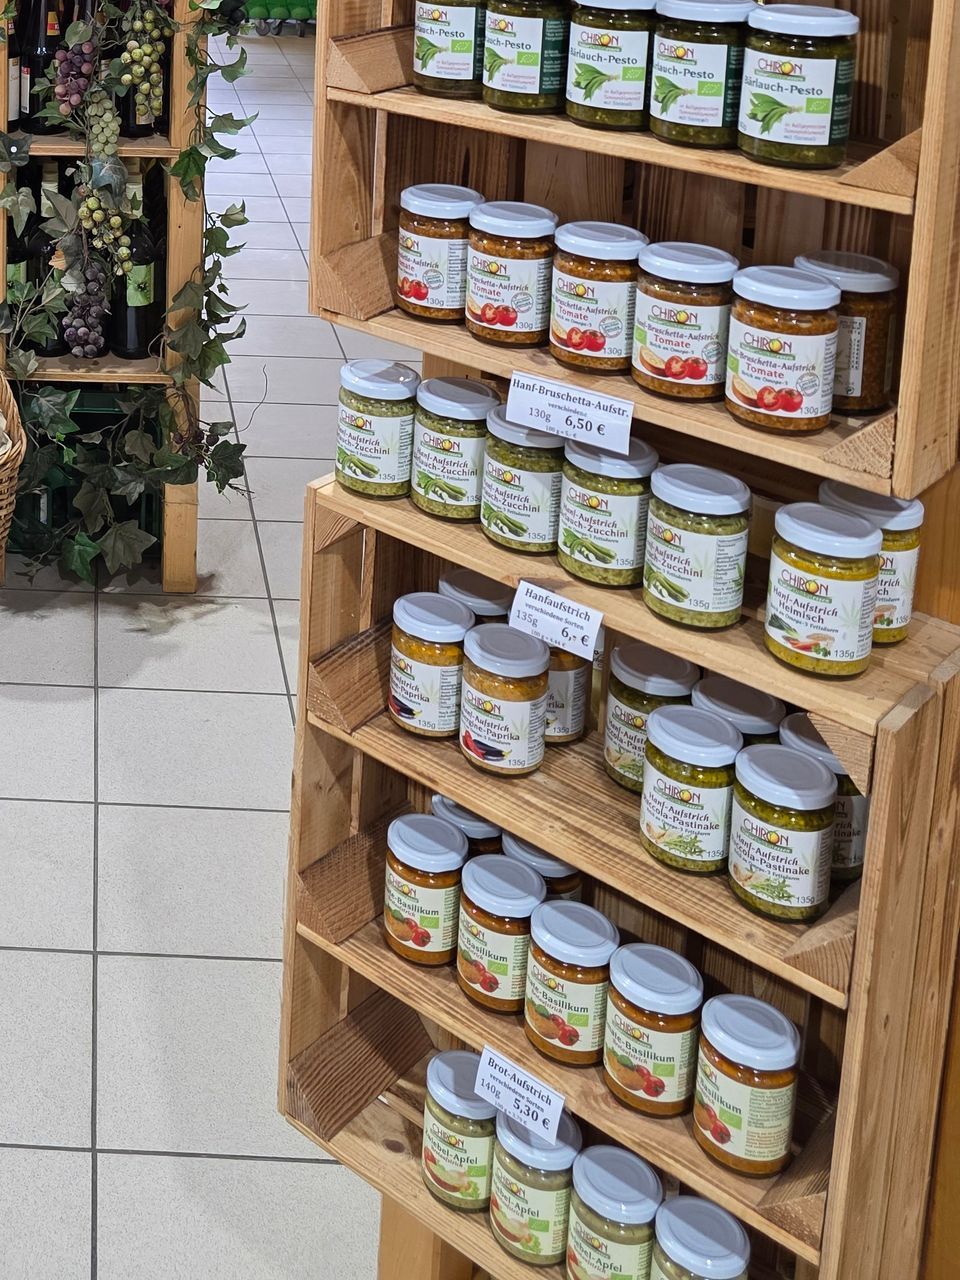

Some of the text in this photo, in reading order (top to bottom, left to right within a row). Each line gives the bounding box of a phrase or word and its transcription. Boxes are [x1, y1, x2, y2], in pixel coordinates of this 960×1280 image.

[580, 31, 619, 46] CHIRON
[758, 57, 802, 75] CHIRON
[744, 75, 823, 96] Bärlauch-Pesto
[473, 283, 501, 298] Tomate
[426, 297, 444, 307] 130g
[559, 306, 589, 321] Tomate
[651, 304, 698, 324] CHIRON
[515, 321, 533, 330] 130g
[602, 347, 622, 356] 130g
[654, 334, 691, 349] Tomate
[743, 332, 792, 352] CHIRON
[705, 373, 722, 382] 130g
[746, 363, 785, 379] Tomate
[513, 378, 629, 417] Hanf-Bruschetta-Aufstr.
[800, 406, 819, 416] 130g
[529, 407, 606, 436] 130g 6,50 €
[422, 432, 461, 451] CHIRON
[417, 447, 469, 469] Hanf-Aufstrich
[379, 473, 396, 481] 135g
[568, 487, 608, 510] CHIRON
[527, 532, 546, 541] 135g
[615, 557, 634, 566] 135g
[781, 569, 830, 596] CHIRON
[525, 588, 590, 622] Hanfaufstrich
[689, 598, 710, 609] 135g
[773, 586, 838, 618] Hanf-Aufstrich
[778, 599, 825, 624] Heimisch
[525, 603, 584, 631] verschiedene Sorten
[516, 610, 538, 628] 135g
[581, 635, 590, 647] €
[834, 649, 855, 659] 135g
[466, 690, 501, 714] CHIRON
[418, 719, 436, 729] 135g
[508, 758, 526, 767] 135g
[655, 778, 701, 804] CHIRON
[648, 791, 709, 822] Hanf-Aufstrich
[743, 818, 789, 846] CHIRON
[735, 833, 799, 866] Hanf-Aufstrich
[795, 895, 815, 904] 135g
[487, 1056, 552, 1106] Brot-Aufstrich
[489, 1072, 545, 1113] verschiedene Sorten
[480, 1077, 551, 1130] 140g 5,30 €
[425, 1128, 478, 1165] Zwiebel-Apfel
